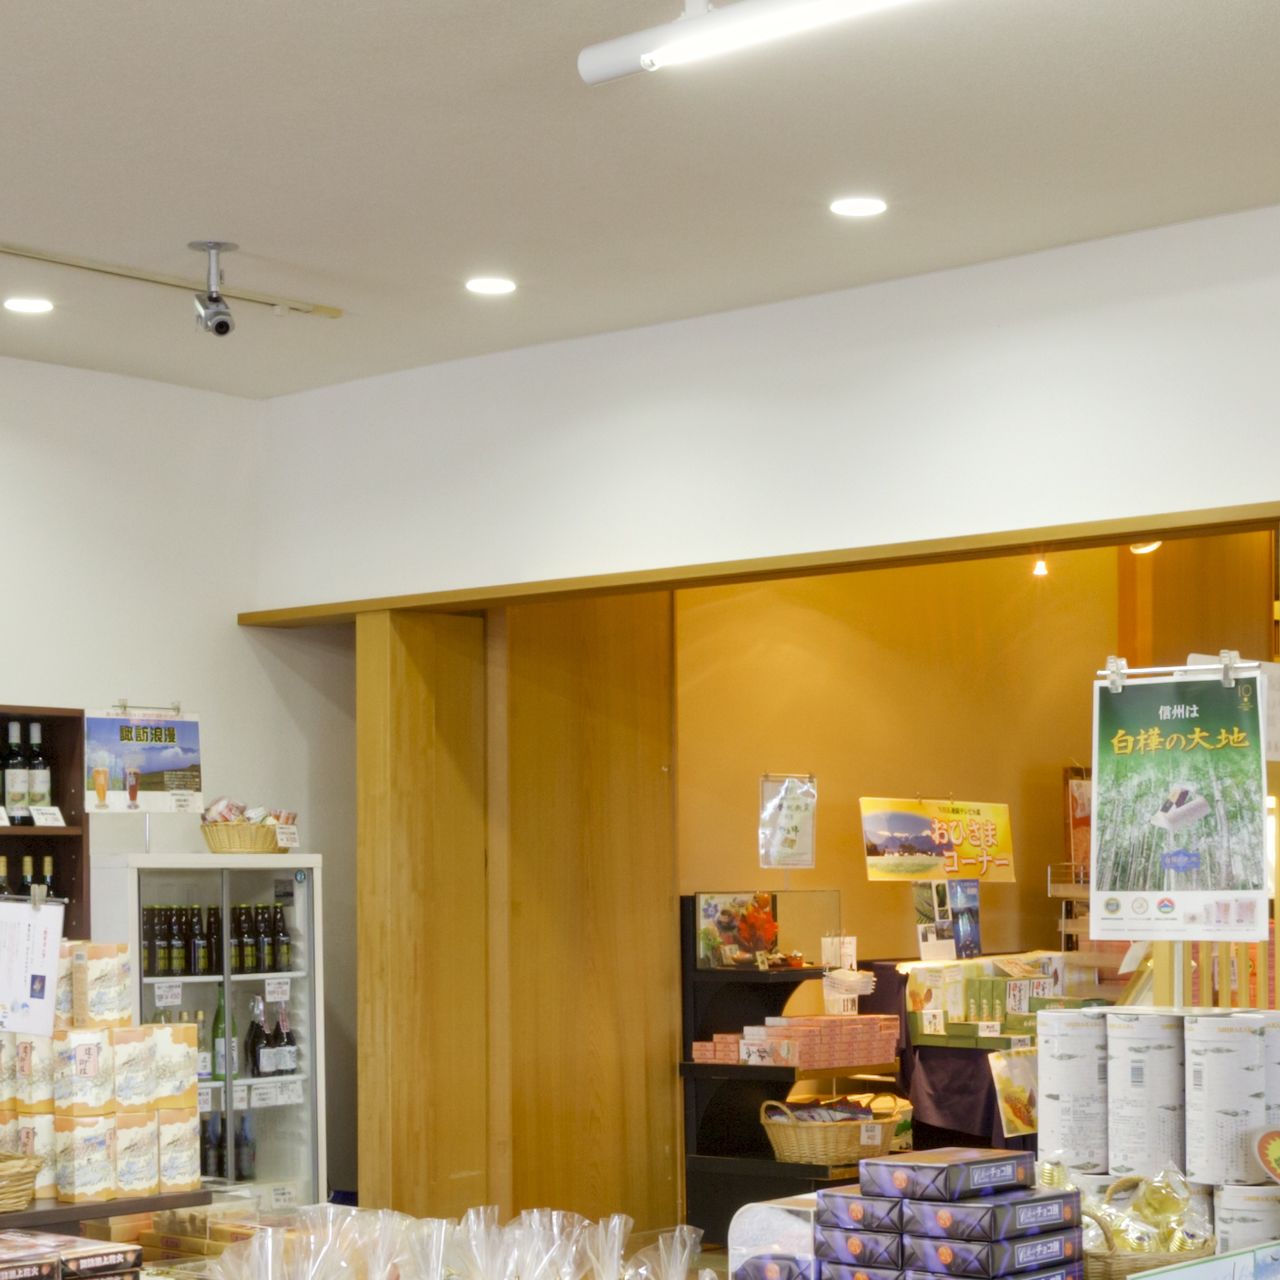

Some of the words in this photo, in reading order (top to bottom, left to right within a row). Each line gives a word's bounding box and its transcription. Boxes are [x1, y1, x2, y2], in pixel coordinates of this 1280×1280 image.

[1158, 703, 1200, 721] 信州は
[119, 725, 177, 744] 諏訪浪漫
[1110, 725, 1252, 756] 白樺の大地
[930, 817, 998, 846] おひさま
[943, 848, 1009, 875] コーナー
